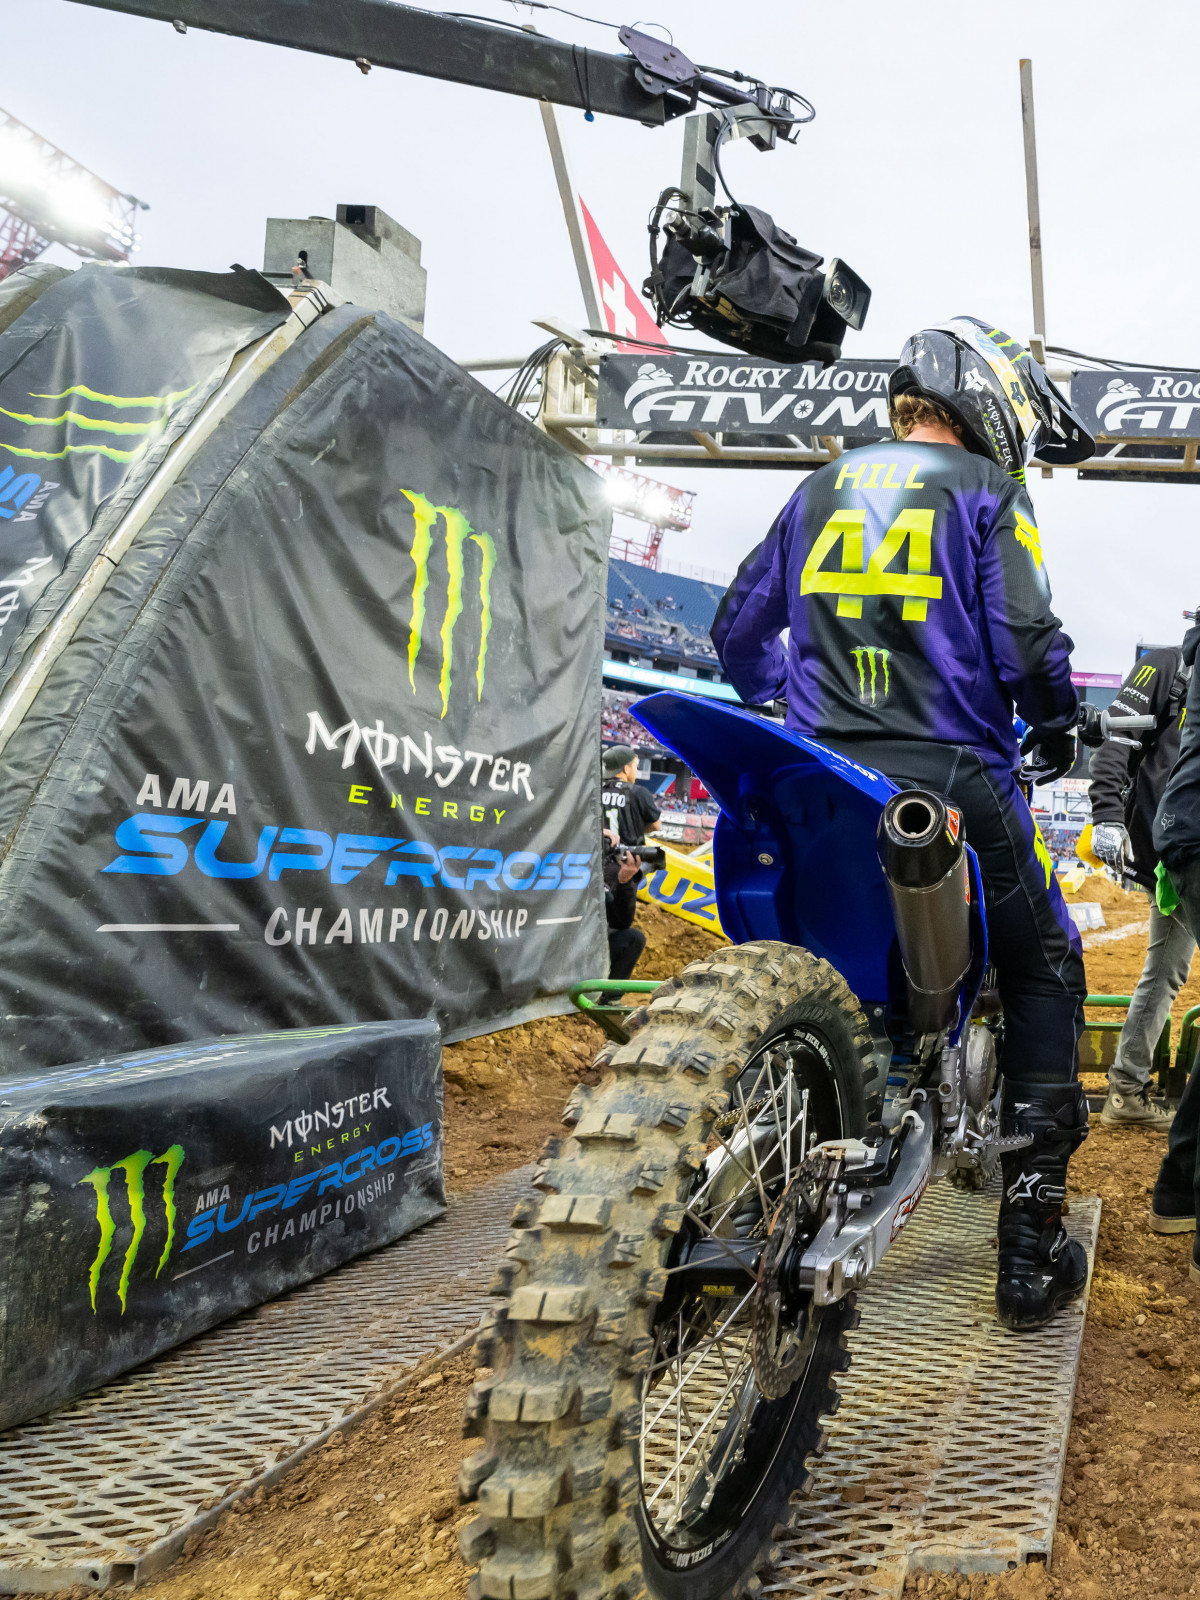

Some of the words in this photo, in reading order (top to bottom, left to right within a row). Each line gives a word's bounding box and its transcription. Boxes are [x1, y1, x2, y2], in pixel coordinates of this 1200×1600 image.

[679, 360, 785, 389] ROCKY
[798, 363, 891, 392] MOUN
[810, 396, 891, 426] M
[985, 397, 1014, 468] MONSTER
[834, 463, 925, 490] HILL
[800, 508, 943, 622] 44
[305, 711, 535, 801] MONSTER
[137, 773, 237, 815] AMA
[348, 784, 507, 825] ENERGY
[601, 791, 627, 808] OTO
[101, 812, 593, 891] SUPERCROSS
[264, 907, 529, 946] CHAMPIONSHIP
[269, 1086, 392, 1150] MONSTER
[293, 1121, 374, 1164] ENERGY
[180, 1121, 435, 1253] SUPERCROSS
[195, 1184, 231, 1213] AMA
[247, 1172, 397, 1254] CHAMPIONSHIP
